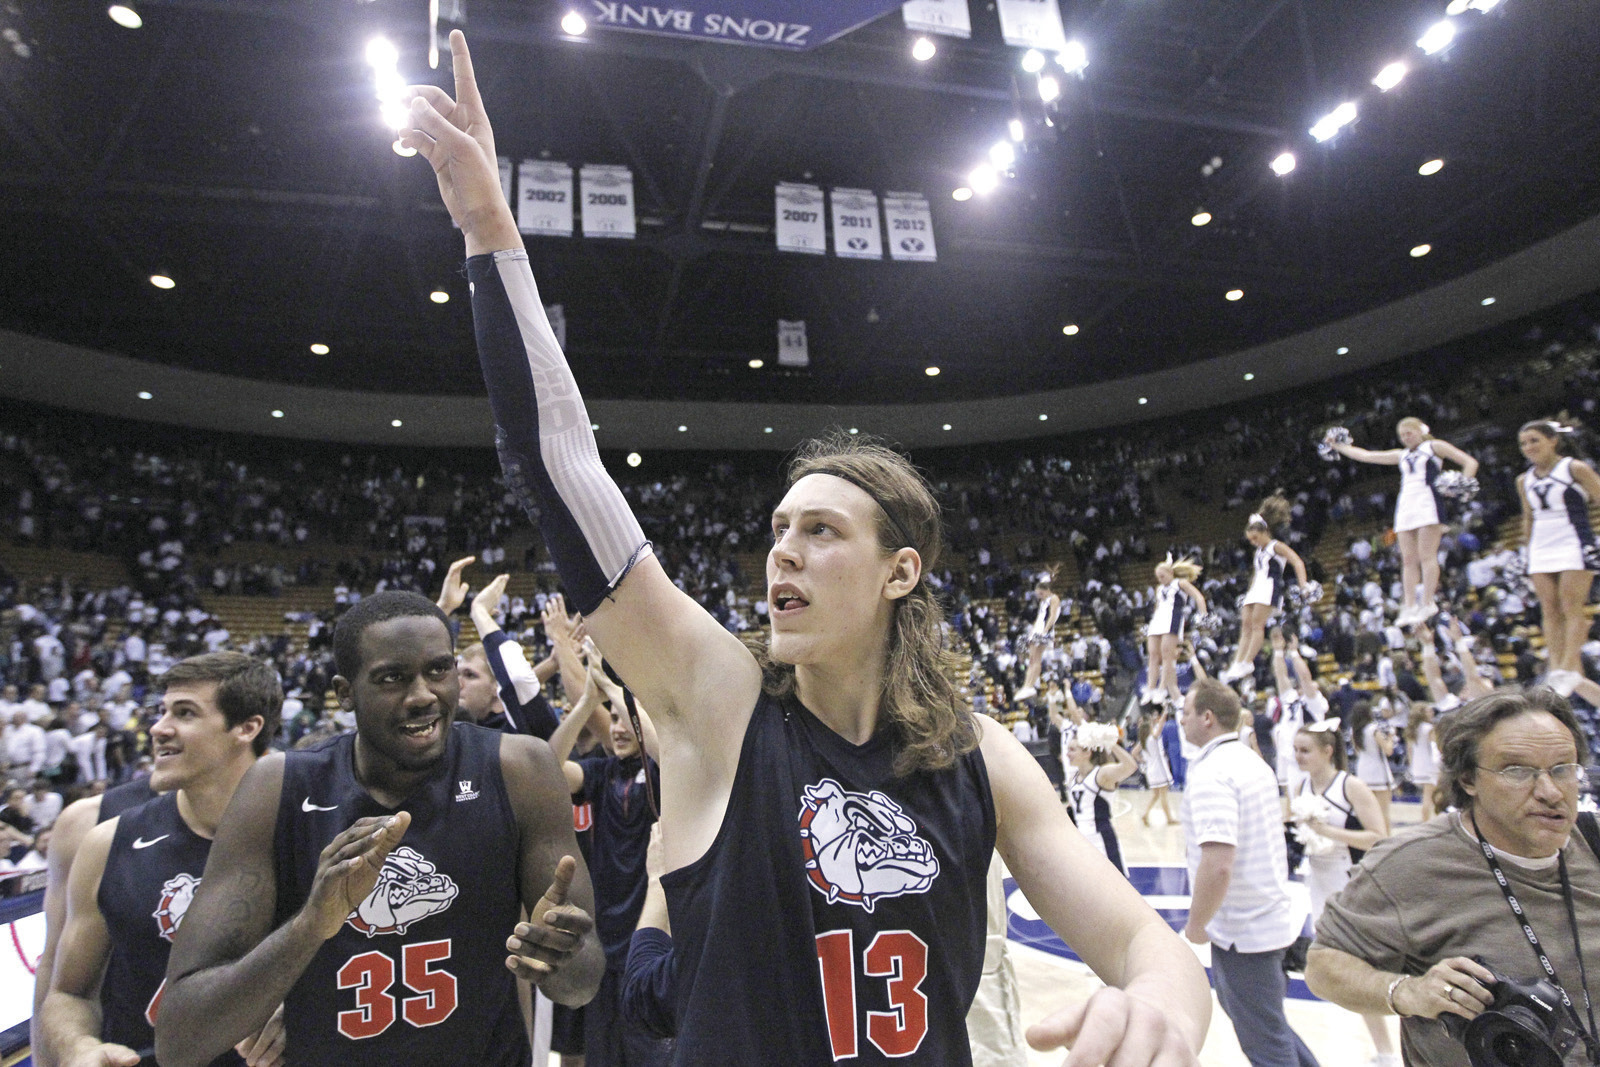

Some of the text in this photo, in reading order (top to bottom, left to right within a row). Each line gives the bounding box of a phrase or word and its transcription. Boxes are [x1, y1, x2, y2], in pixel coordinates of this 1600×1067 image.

[594, 0, 812, 45] ZIONS BANK
[526, 188, 566, 203] 2002
[783, 209, 818, 223] 2007
[840, 215, 872, 228] 2011
[894, 218, 926, 231] 2012
[1533, 483, 1554, 510] Y
[337, 938, 458, 1040] 35
[815, 929, 928, 1062] 13
